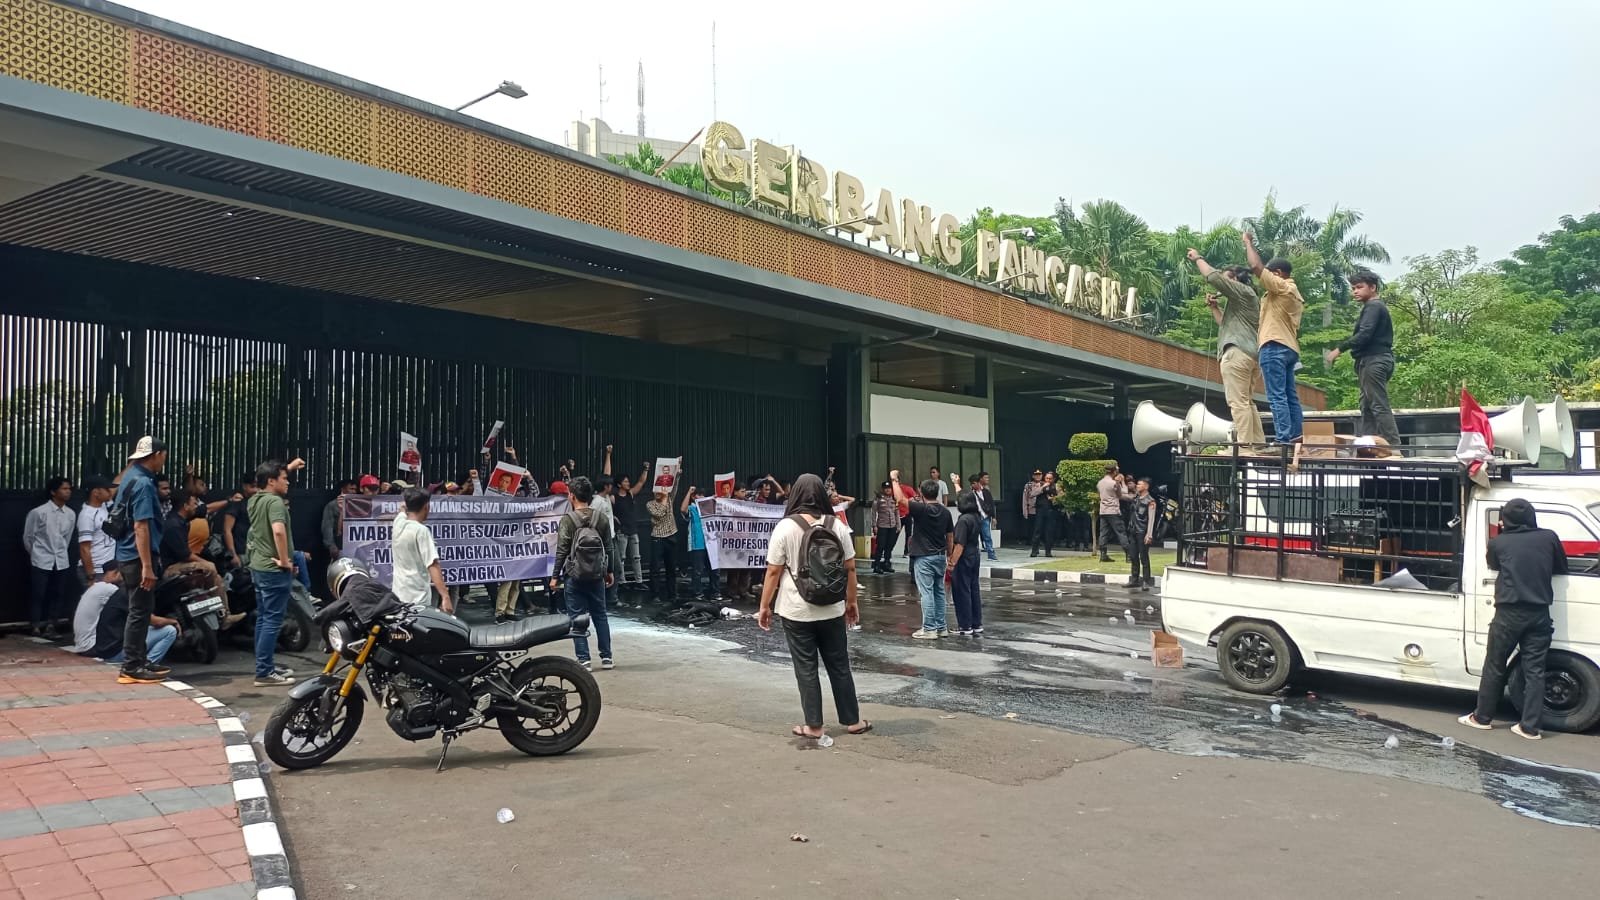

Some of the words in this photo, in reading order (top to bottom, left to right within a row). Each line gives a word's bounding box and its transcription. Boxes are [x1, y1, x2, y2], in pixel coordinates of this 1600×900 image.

[700, 120, 962, 266] GERBANG
[349, 525, 393, 542] MABE
[459, 523, 519, 539] PESULAP
[523, 520, 559, 536] BESA
[737, 521, 746, 532] DI
[748, 521, 778, 533] INDON
[505, 541, 549, 558] NAMA
[722, 538, 769, 550] PROFESOR
[747, 555, 768, 567] PEN
[441, 565, 506, 583] RSANGKA
